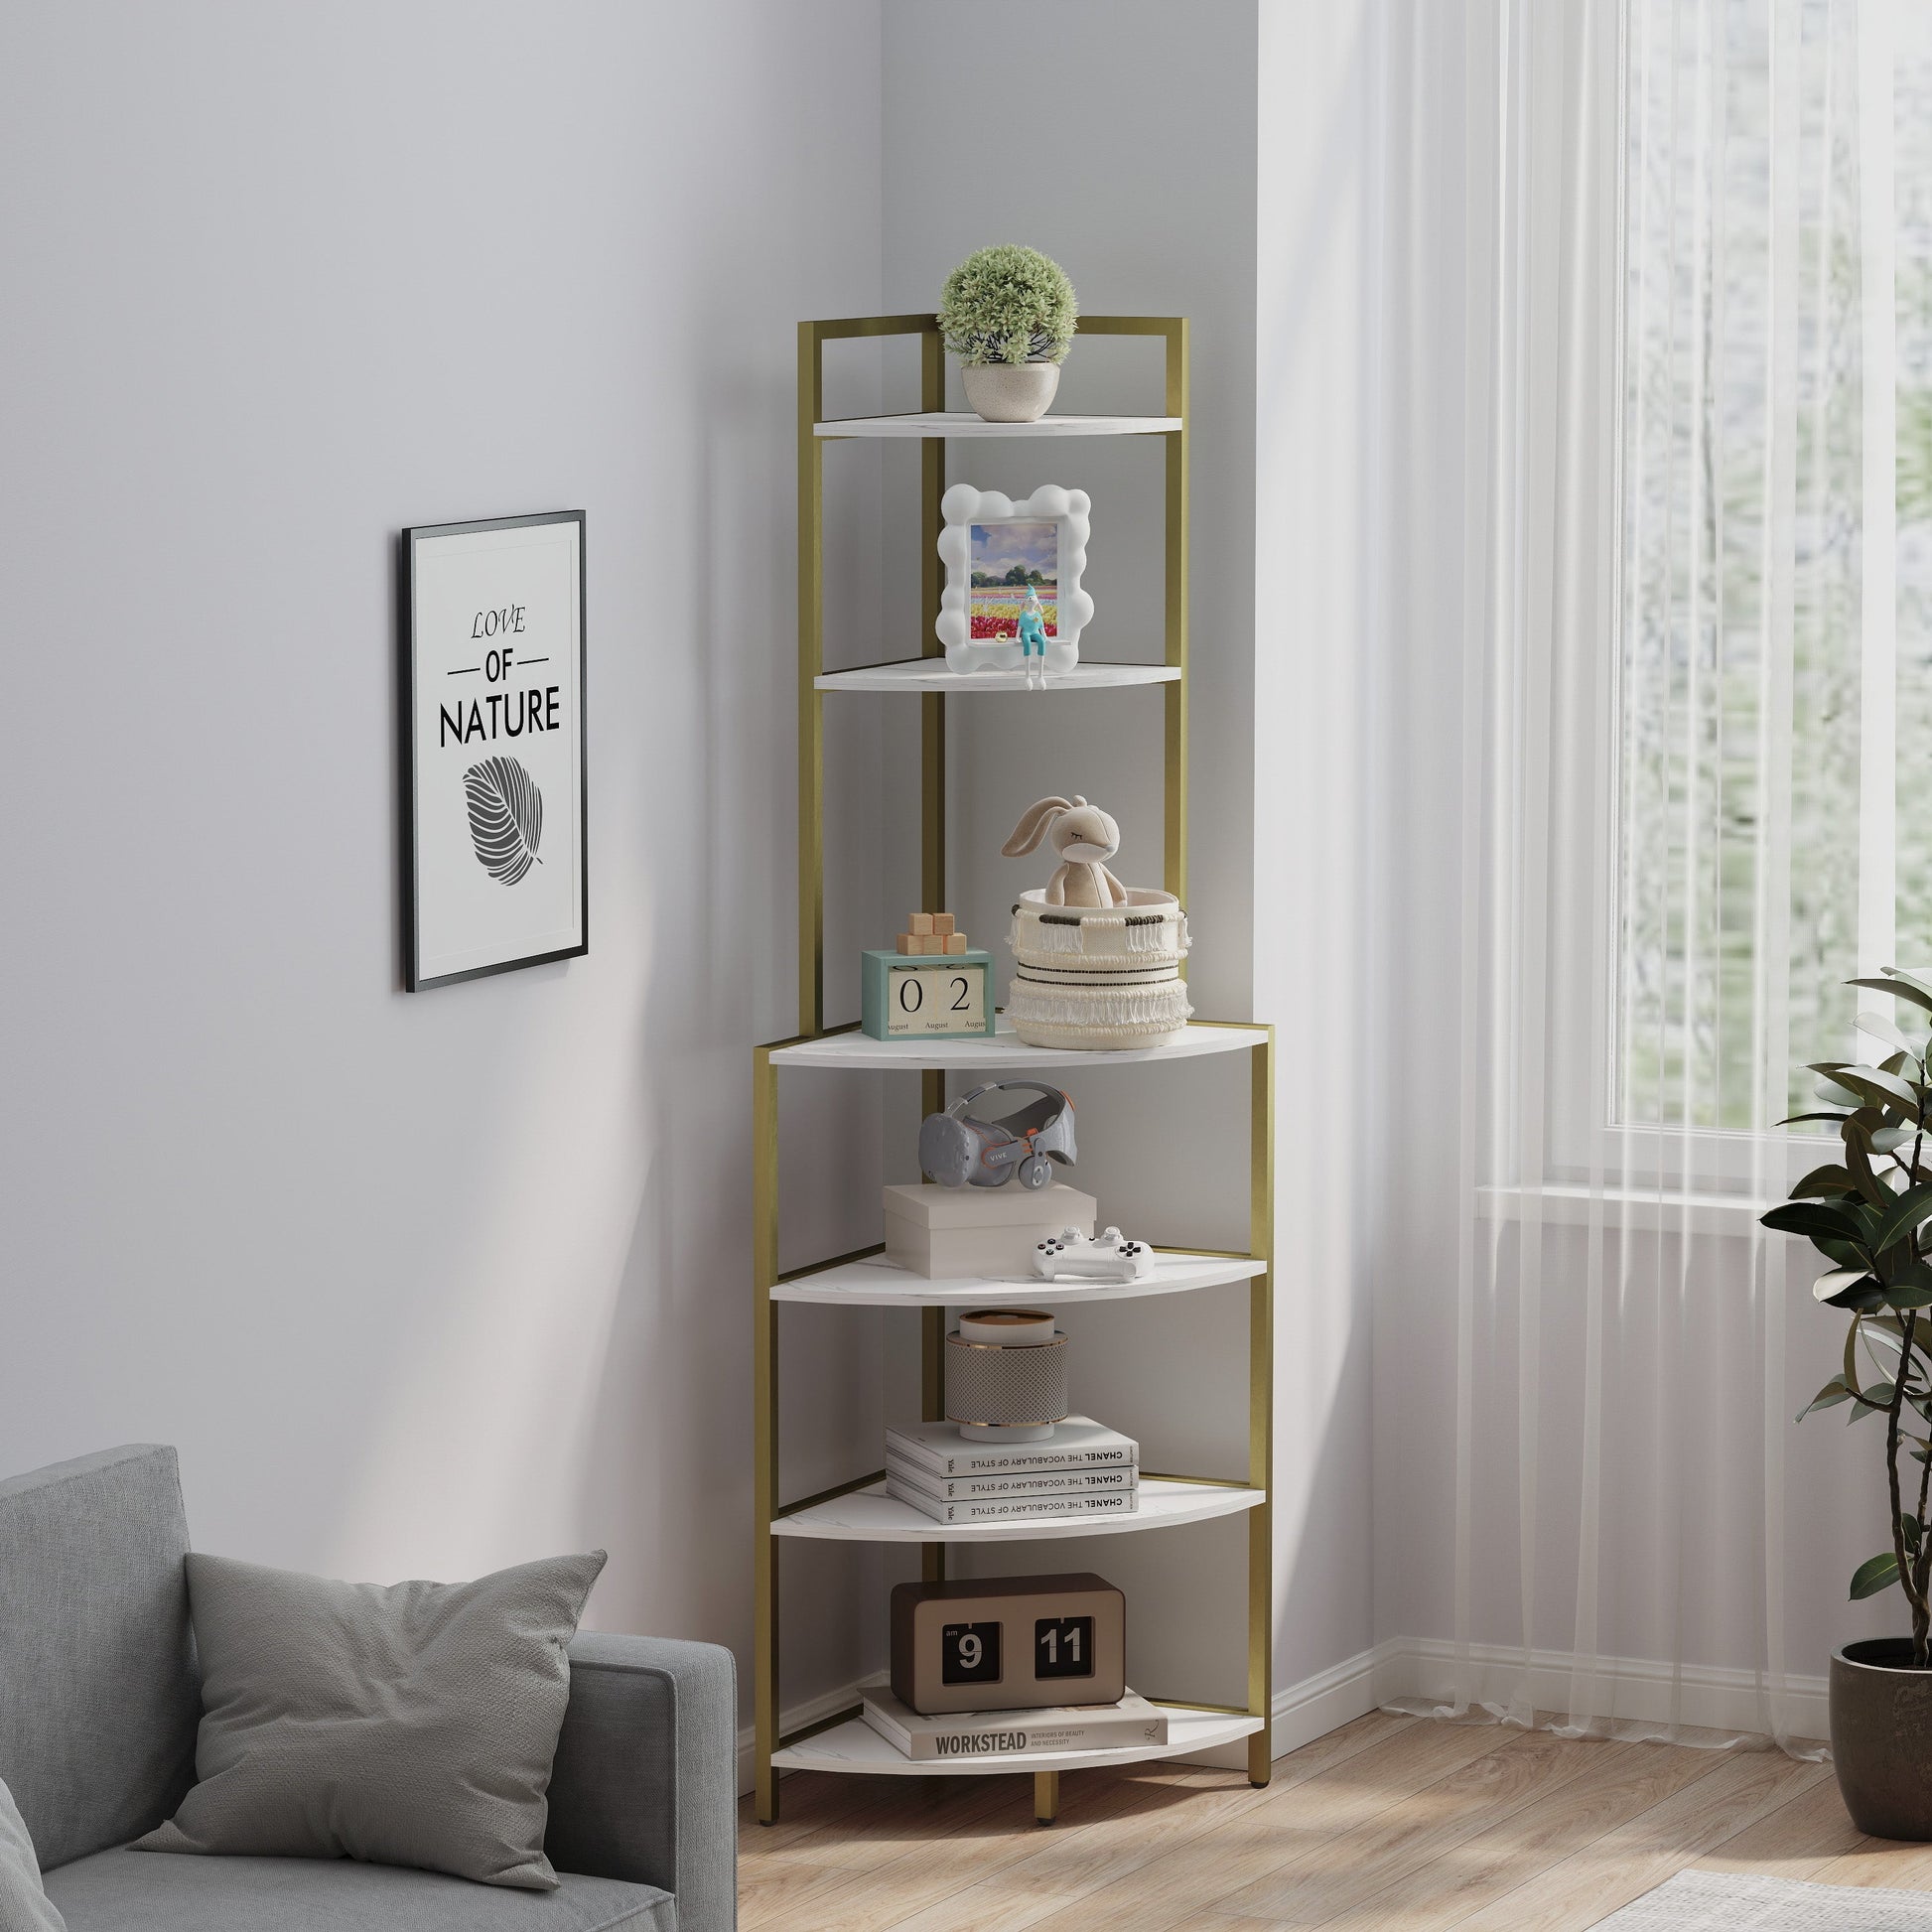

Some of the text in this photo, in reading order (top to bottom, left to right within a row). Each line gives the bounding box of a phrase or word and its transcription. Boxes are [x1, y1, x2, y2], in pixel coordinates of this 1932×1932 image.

[471, 604, 526, 639] LOVE
[485, 647, 514, 683] OF
[440, 685, 560, 748] NATURE
[899, 977, 971, 1013] 0 2
[925, 1022, 948, 1031] August
[990, 1151, 1007, 1162] VIVE
[1011, 1455, 1065, 1466] VOCABULARY
[1085, 1451, 1123, 1461] CHANEL
[971, 1459, 996, 1468] STYLE
[1011, 1478, 1065, 1489] VOCABULARY
[1085, 1474, 1123, 1485] CHANEL
[971, 1483, 996, 1492] STYLE
[1011, 1502, 1065, 1513] VOCABULARY
[1085, 1498, 1123, 1508] CHANEL
[971, 1507, 996, 1516] STYLE
[958, 1627, 1080, 1668] 9 11
[935, 1731, 1027, 1754] WORKSTEAD
